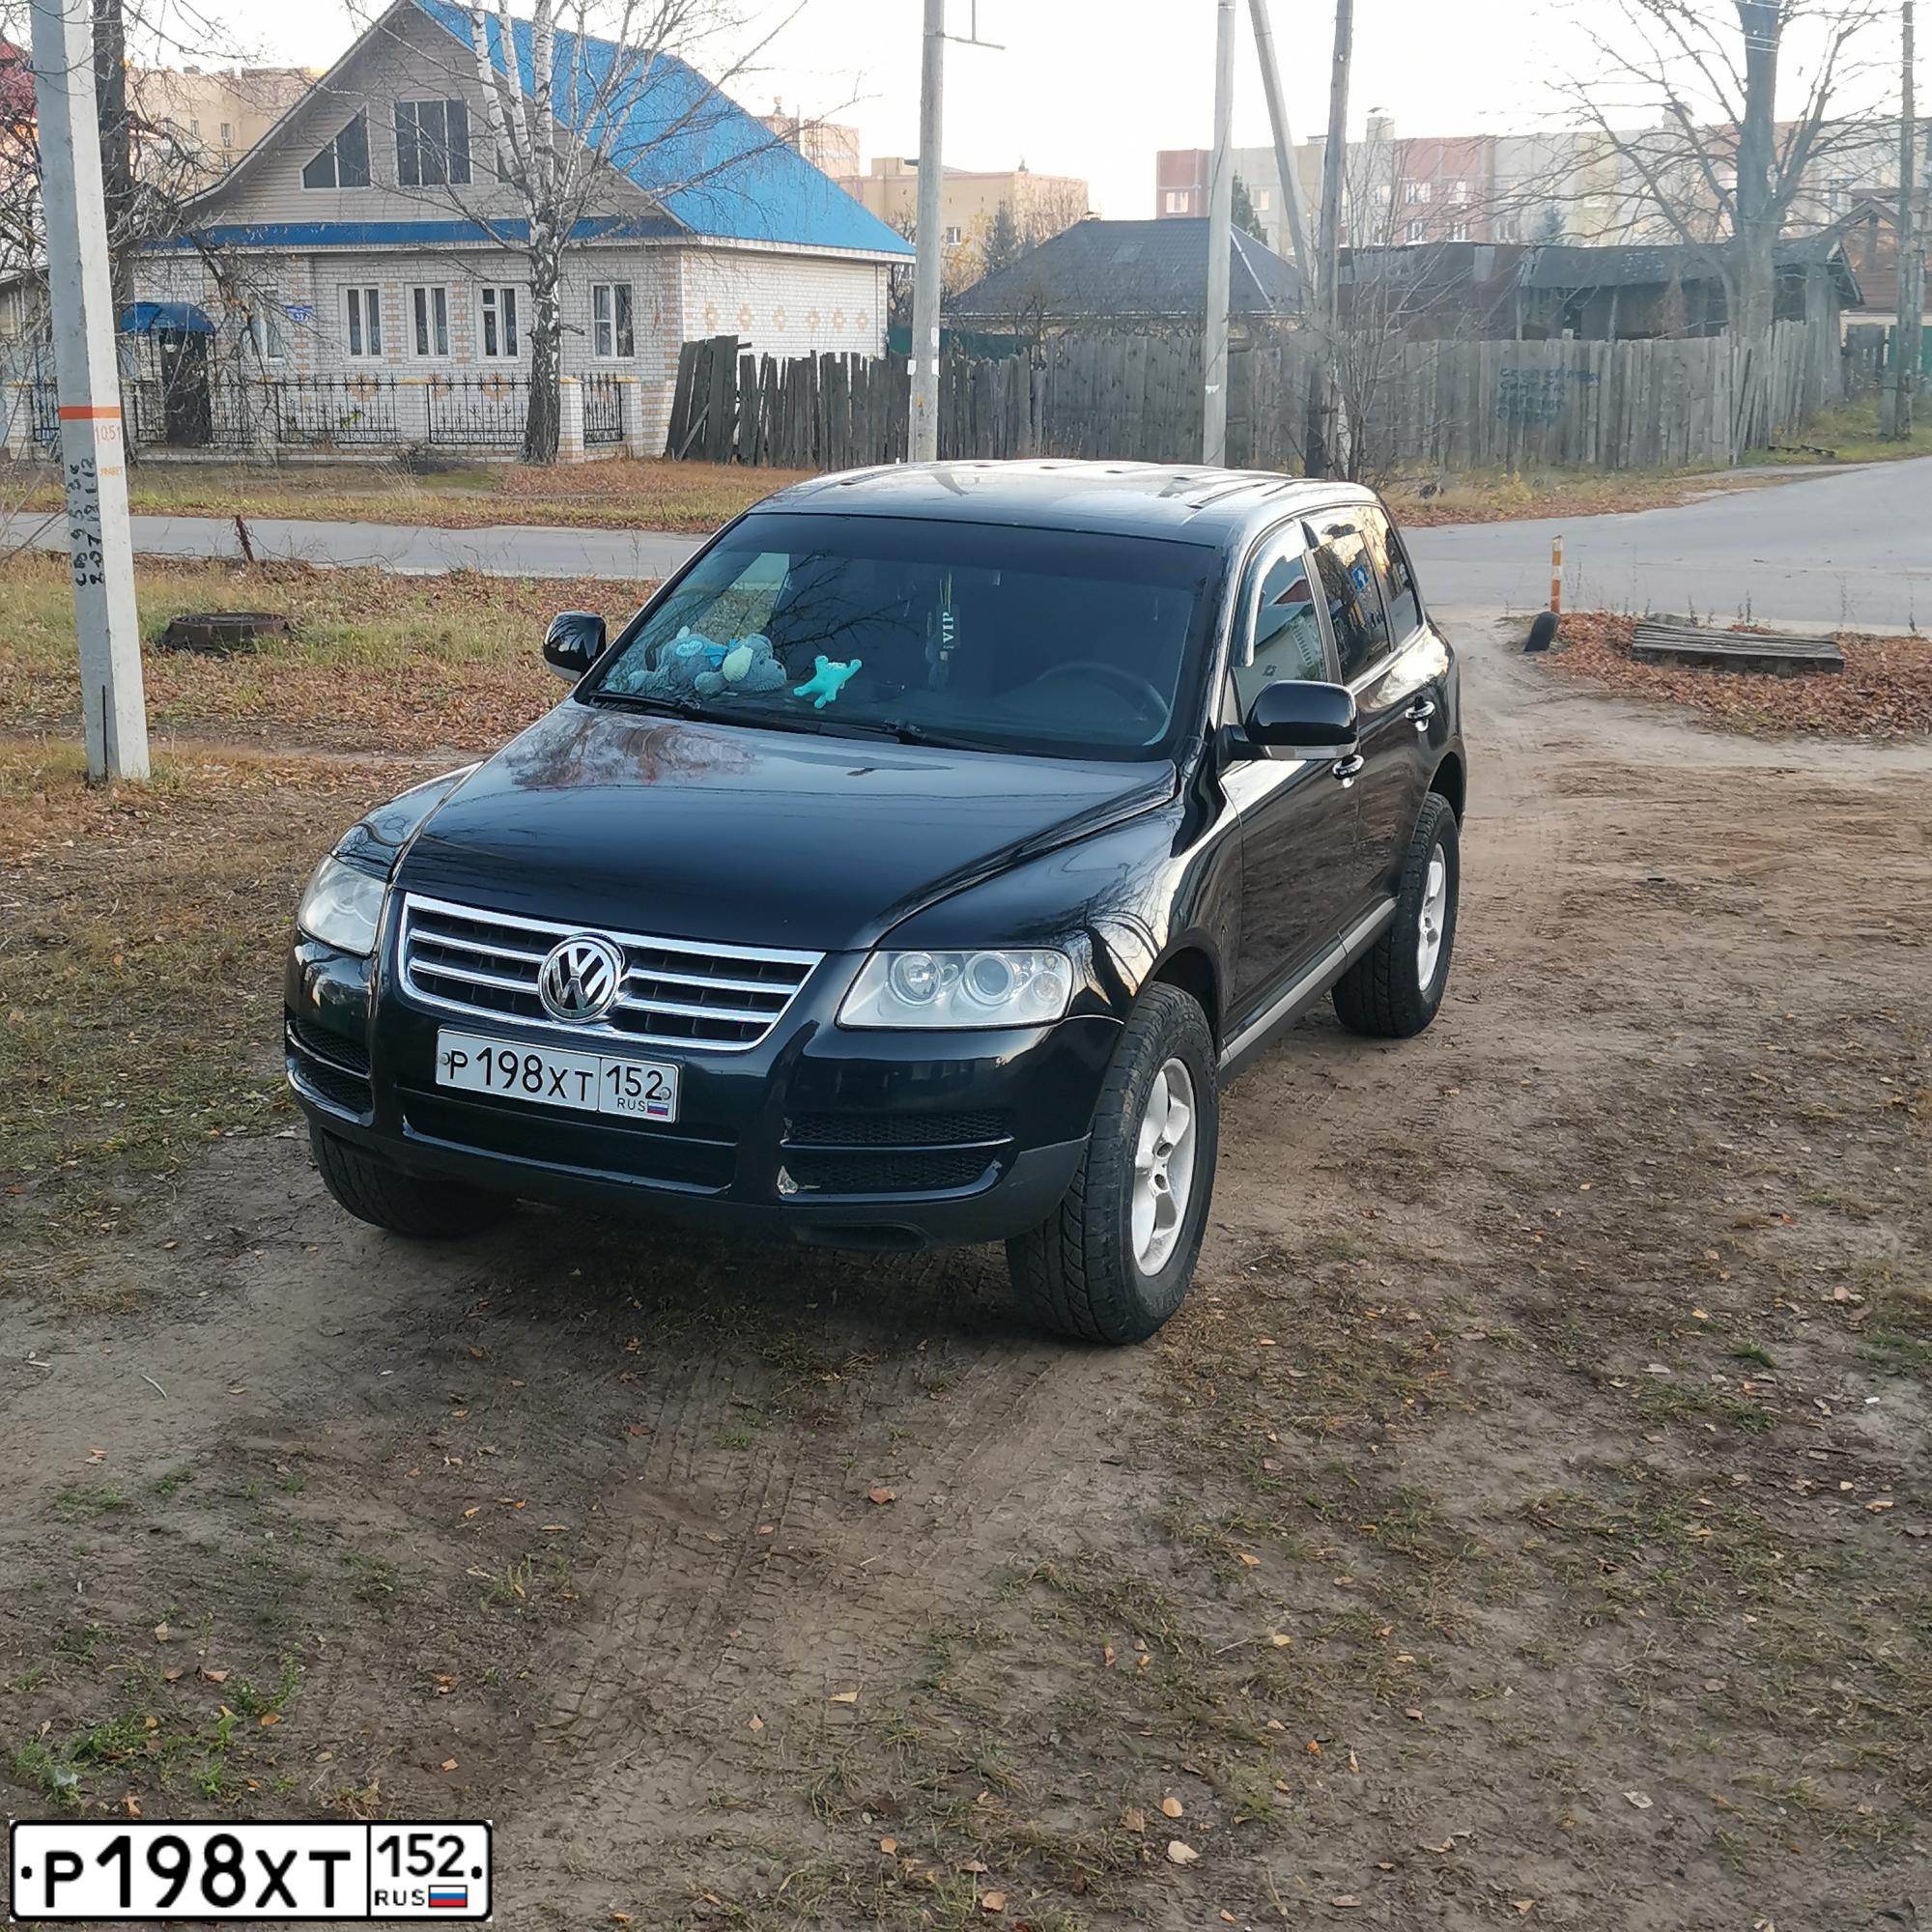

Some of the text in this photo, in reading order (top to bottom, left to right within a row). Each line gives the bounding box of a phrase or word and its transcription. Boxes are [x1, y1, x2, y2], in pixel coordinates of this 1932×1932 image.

[95, 425, 121, 443] 1051
[606, 1065, 665, 1101] 152
[616, 1097, 646, 1112] RUS
